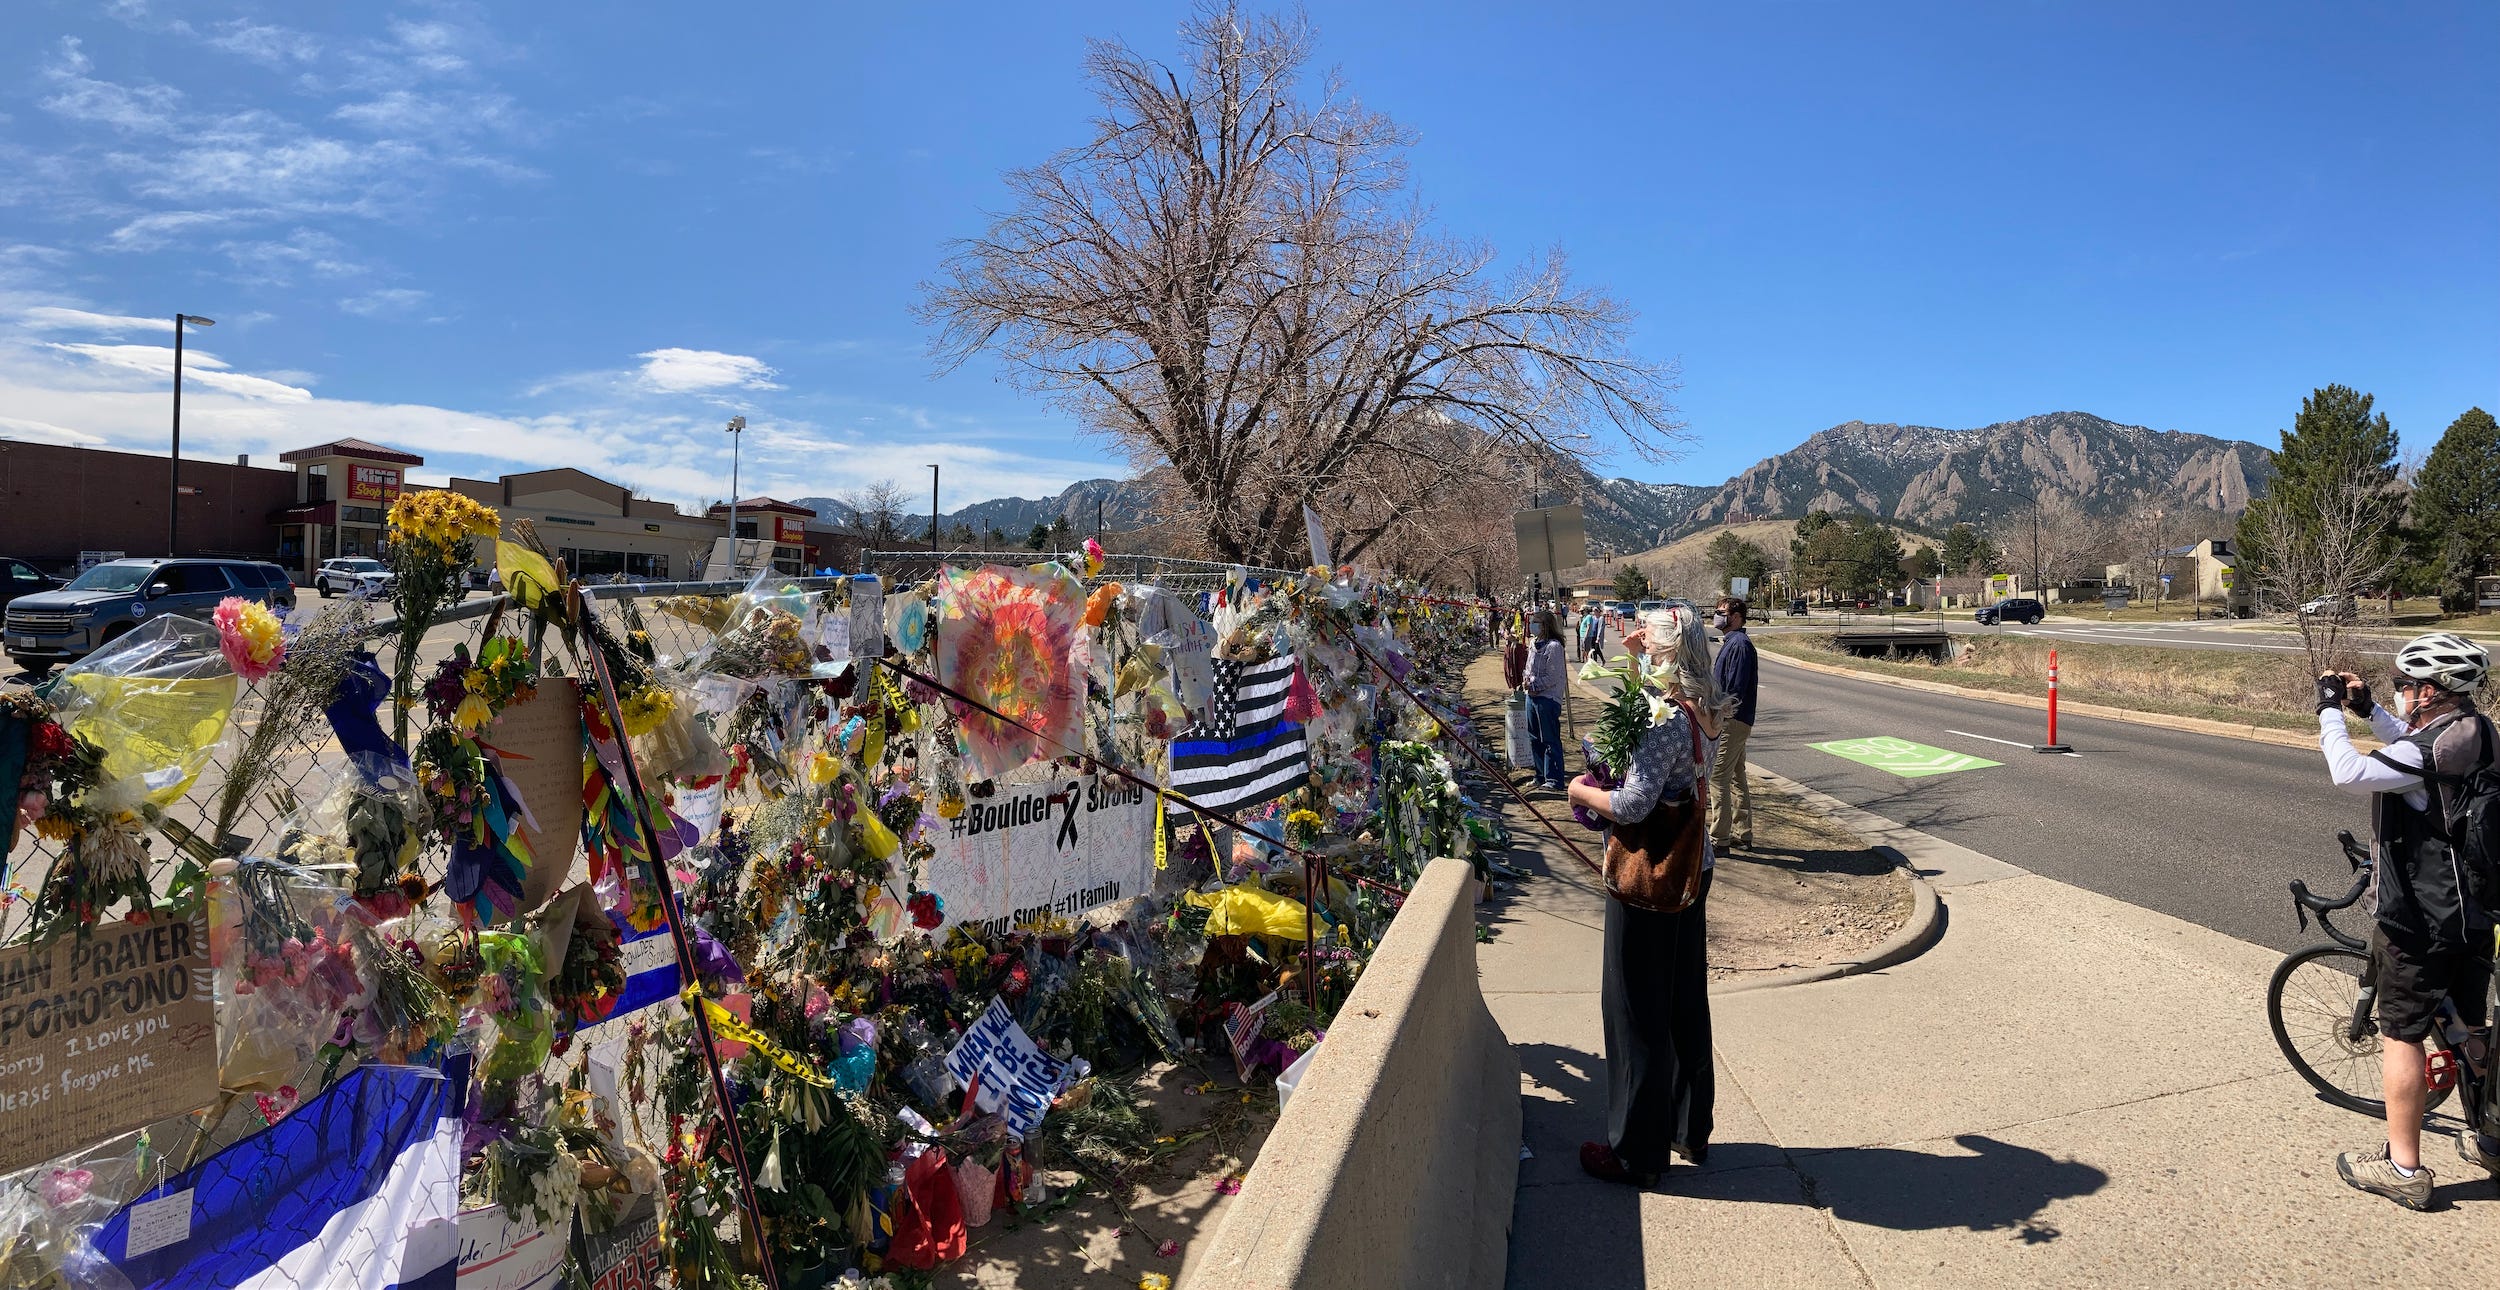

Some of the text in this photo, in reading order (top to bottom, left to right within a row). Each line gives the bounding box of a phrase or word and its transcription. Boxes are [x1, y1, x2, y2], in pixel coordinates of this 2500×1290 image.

[355, 482, 397, 499] Sooprs
[1079, 880, 1121, 909] Family
[70, 922, 192, 983] PRAYER
[65, 1038, 82, 1057] I
[85, 1024, 131, 1051] LOVE
[949, 1026, 993, 1083] WHEN
[978, 1036, 1029, 1098] IT BE
